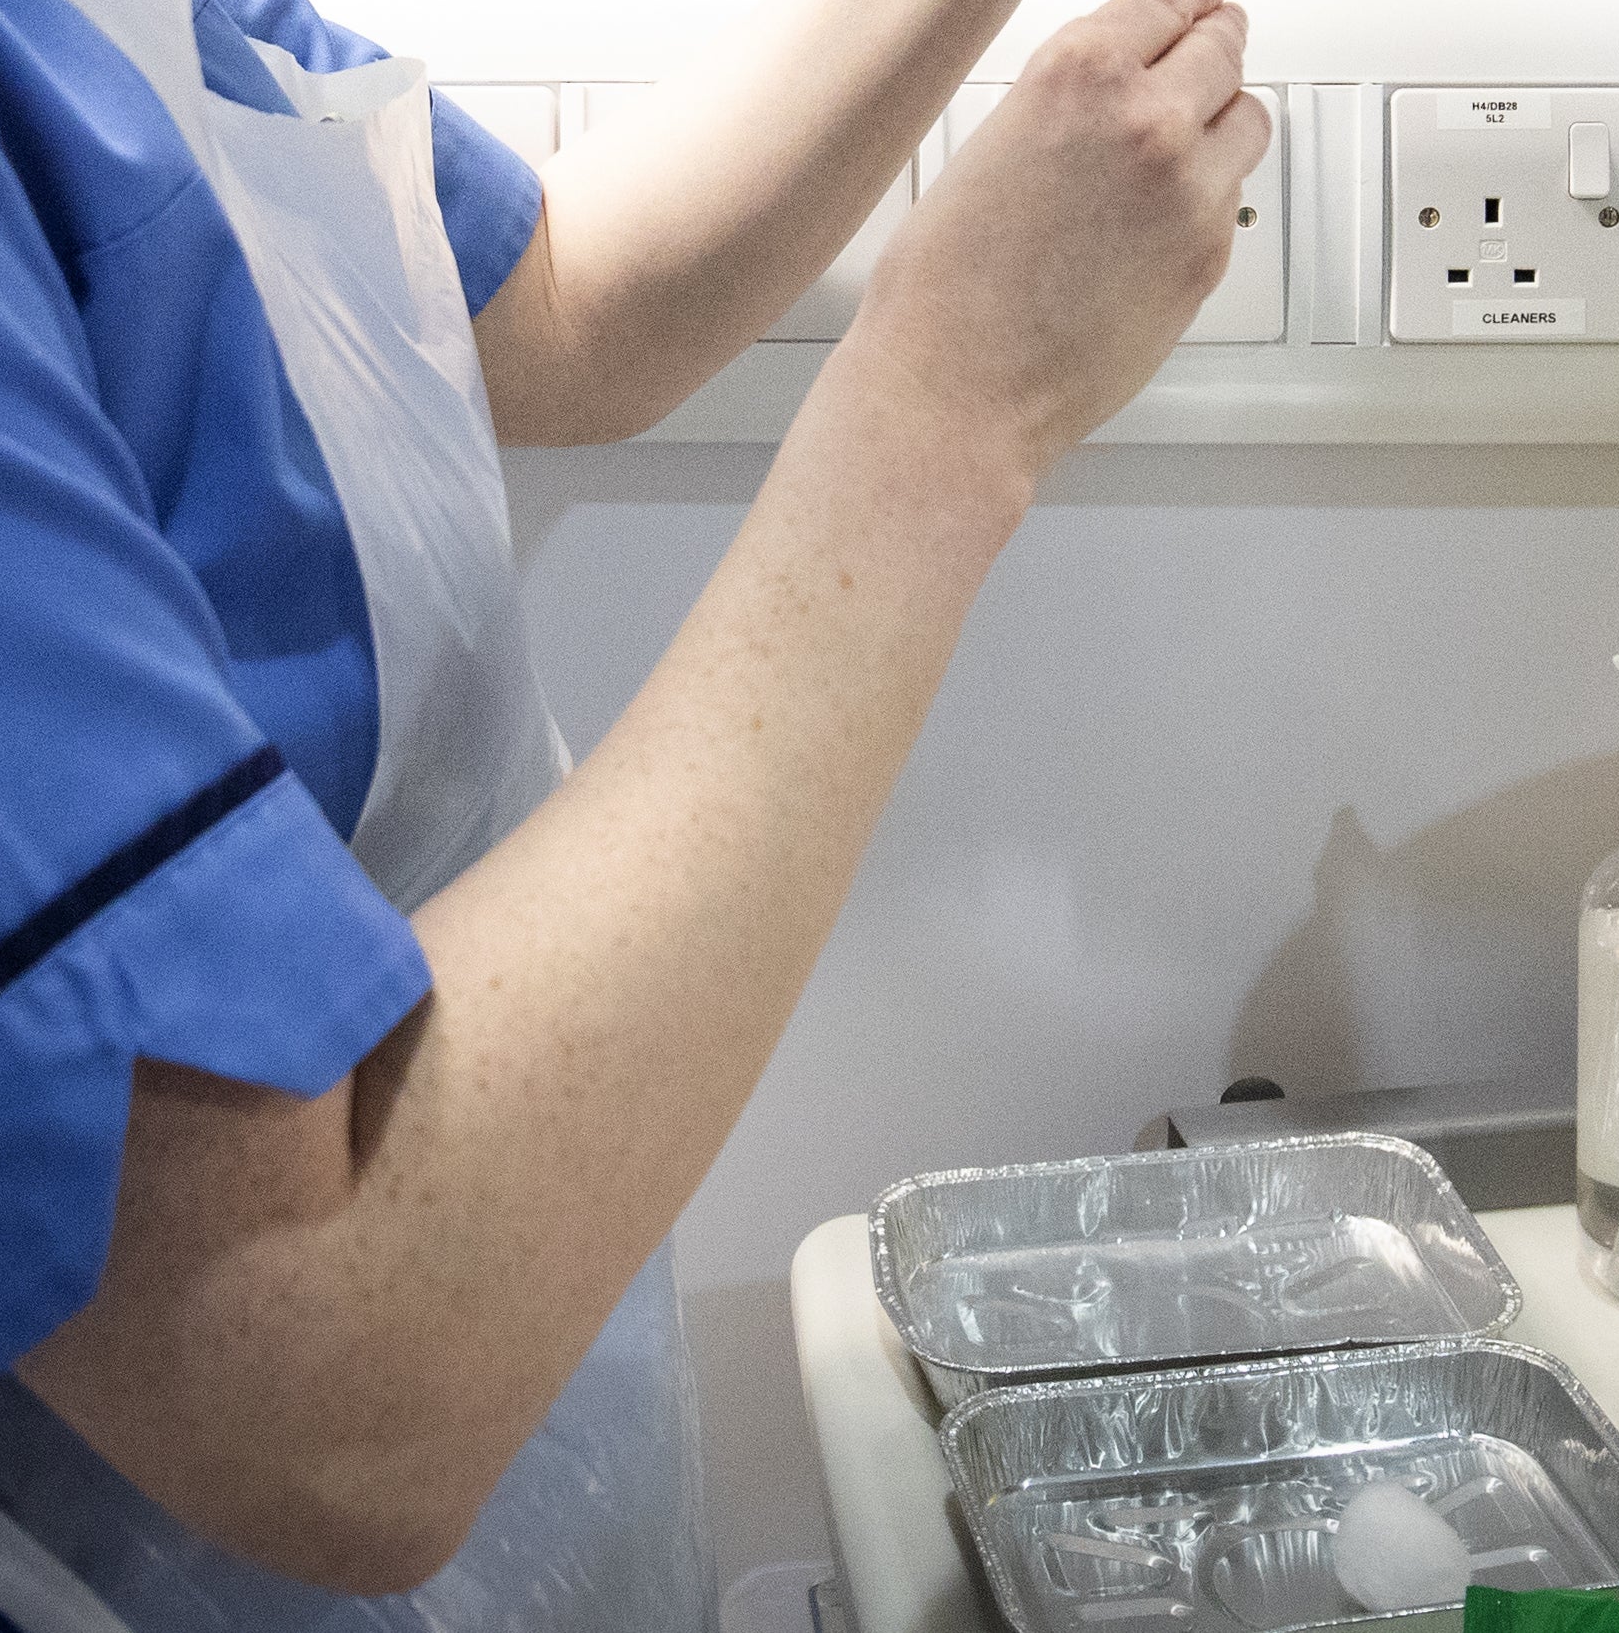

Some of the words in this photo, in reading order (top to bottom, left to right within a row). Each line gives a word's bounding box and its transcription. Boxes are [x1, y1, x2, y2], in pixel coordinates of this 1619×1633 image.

[1471, 101, 1519, 112] H4/DB28
[1485, 113, 1505, 124] 5L2
[1482, 312, 1557, 324] CLEANERS
